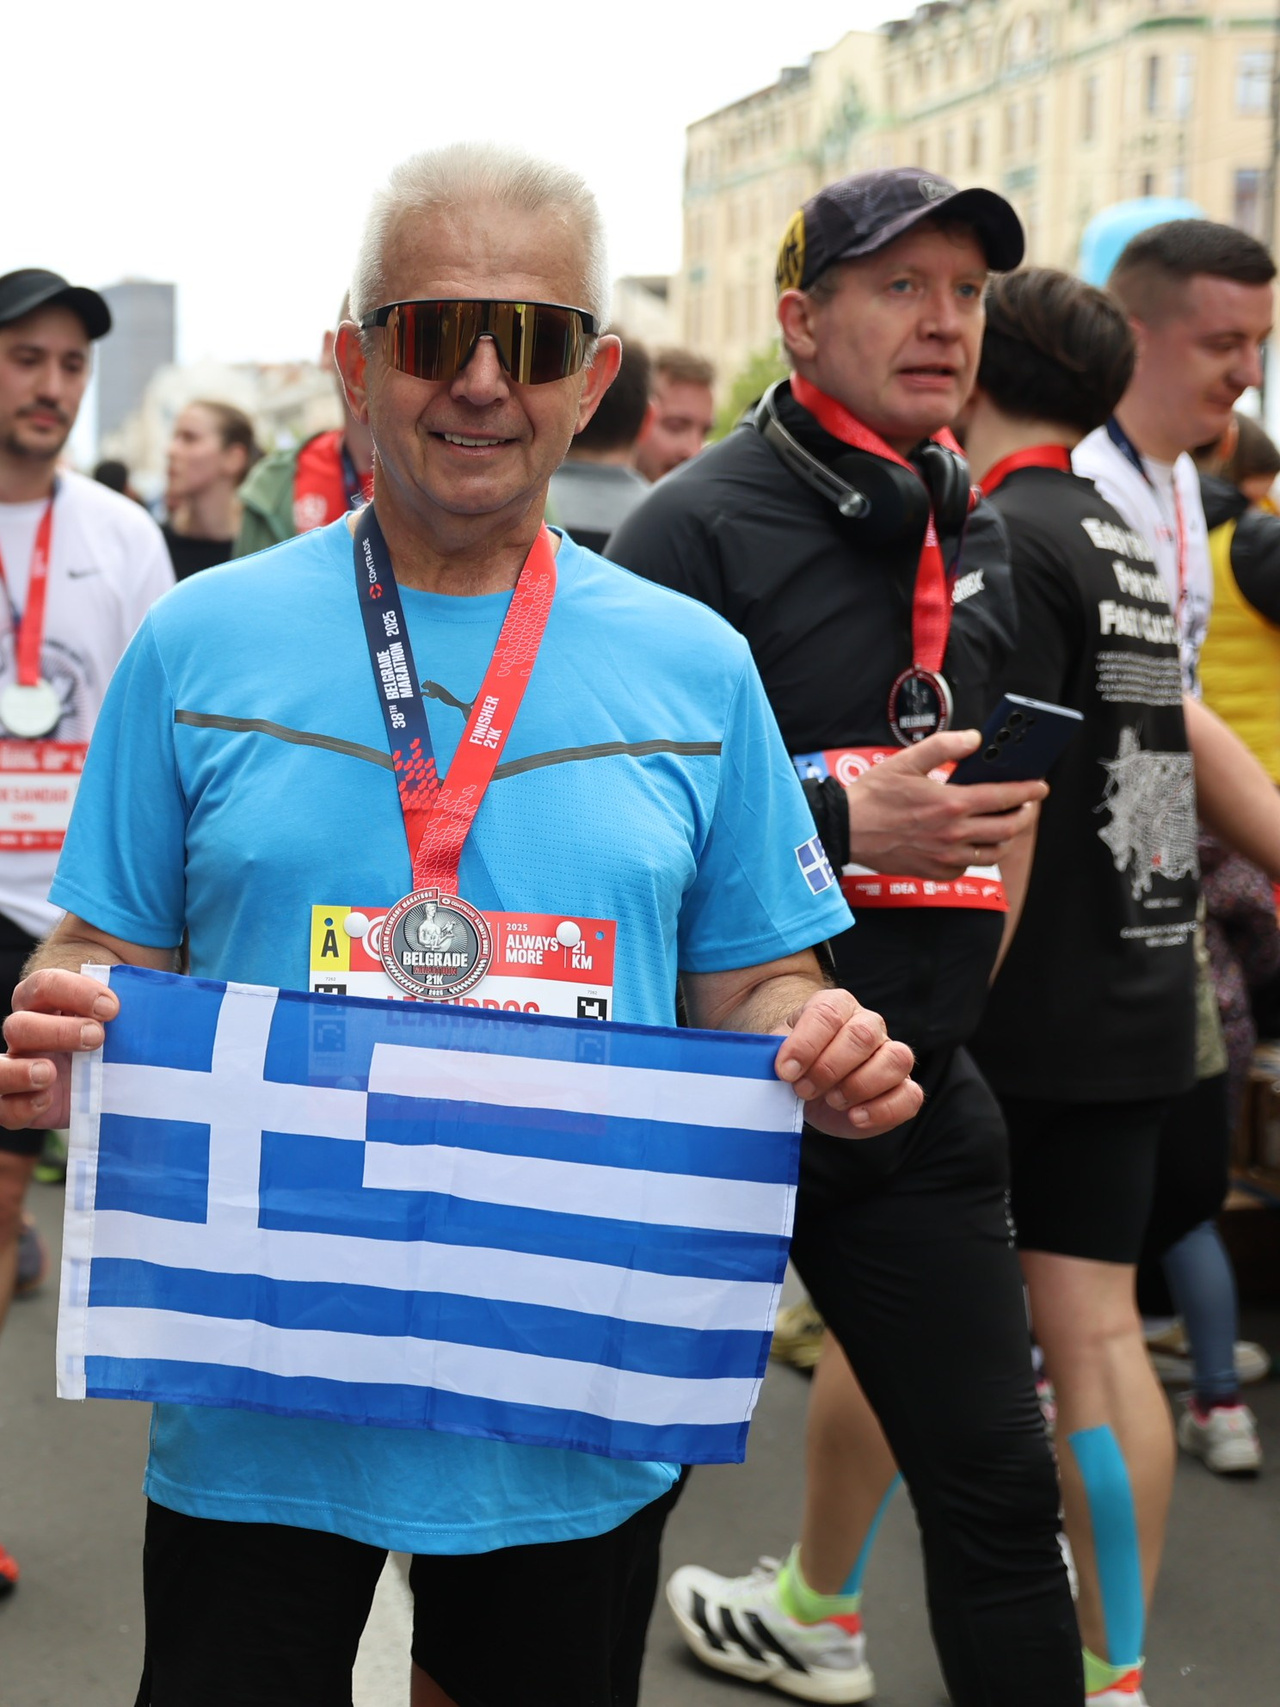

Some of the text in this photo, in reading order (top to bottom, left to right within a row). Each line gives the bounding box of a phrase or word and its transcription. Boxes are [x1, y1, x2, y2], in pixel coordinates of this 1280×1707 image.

[363, 538, 378, 583] COMTRADE
[382, 610, 400, 637] 2025
[377, 649, 400, 700] BELGRADE
[389, 641, 414, 699] MARATHON
[469, 696, 500, 746] FINISHER
[483, 727, 503, 750] 21K
[506, 923, 528, 931] 2025
[321, 929, 339, 958] A
[506, 934, 559, 952] ALWAYS
[572, 940, 586, 954] 21
[402, 951, 468, 967] BELGRADE
[505, 949, 544, 965] MORE
[572, 954, 593, 970] KM
[425, 974, 444, 985] 21K
